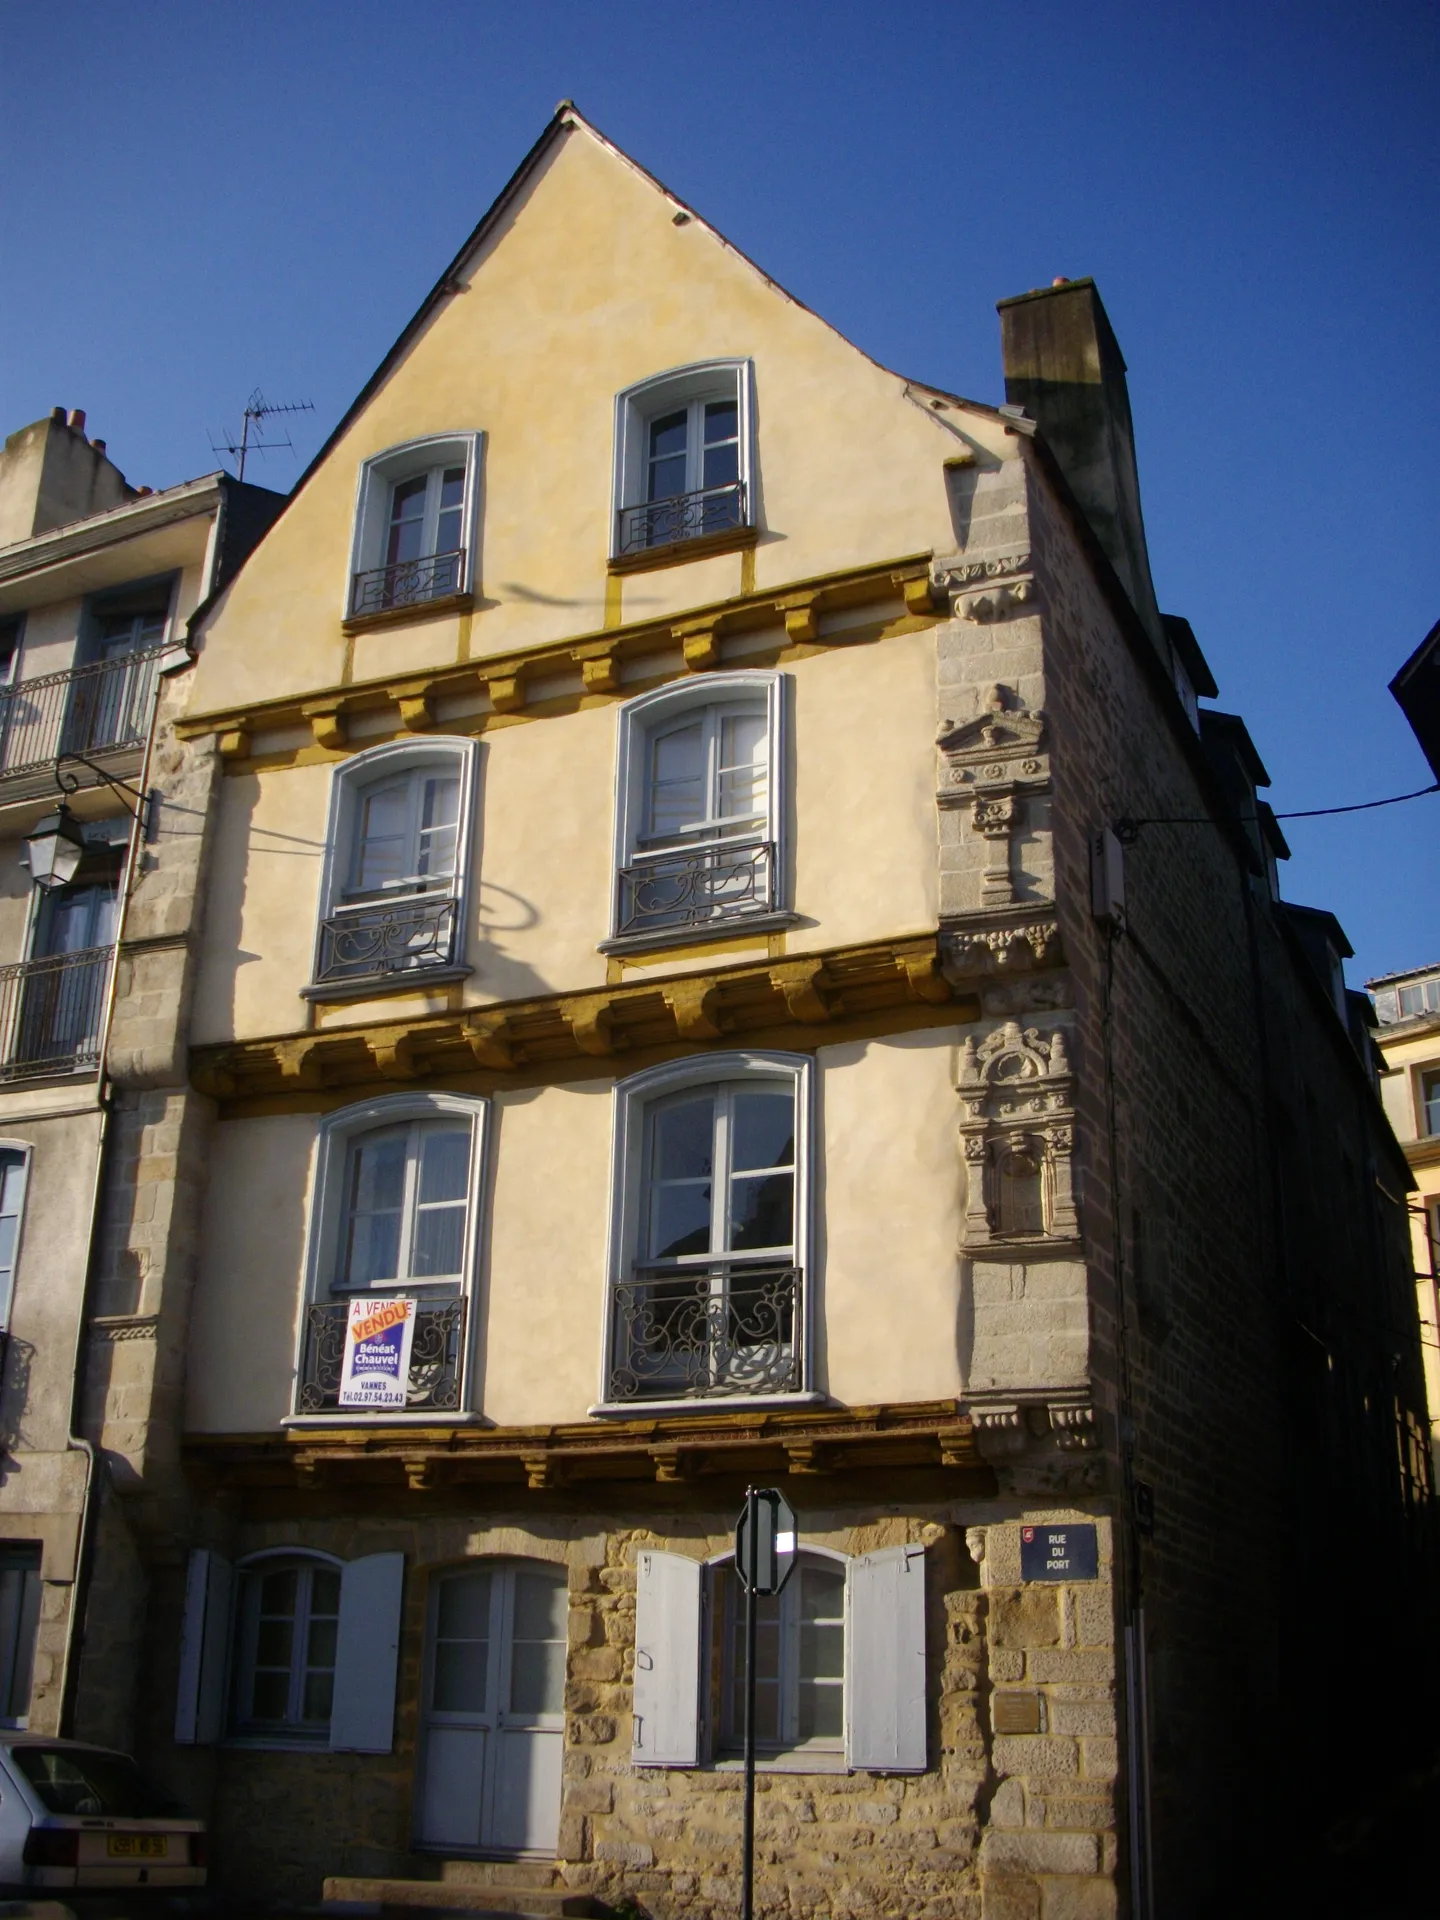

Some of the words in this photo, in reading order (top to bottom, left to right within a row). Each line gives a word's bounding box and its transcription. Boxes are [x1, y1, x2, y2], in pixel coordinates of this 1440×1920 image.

[353, 1302, 361, 1316] A
[366, 1302, 413, 1316] VENE
[352, 1302, 407, 1340] VENDU
[360, 1343, 396, 1354] Bénéat
[355, 1353, 398, 1365] Chauvel
[361, 1381, 387, 1391] VANNES
[1048, 1534, 1067, 1545] RUE
[1051, 1547, 1065, 1557] DU
[1046, 1560, 1071, 1570] PORT
